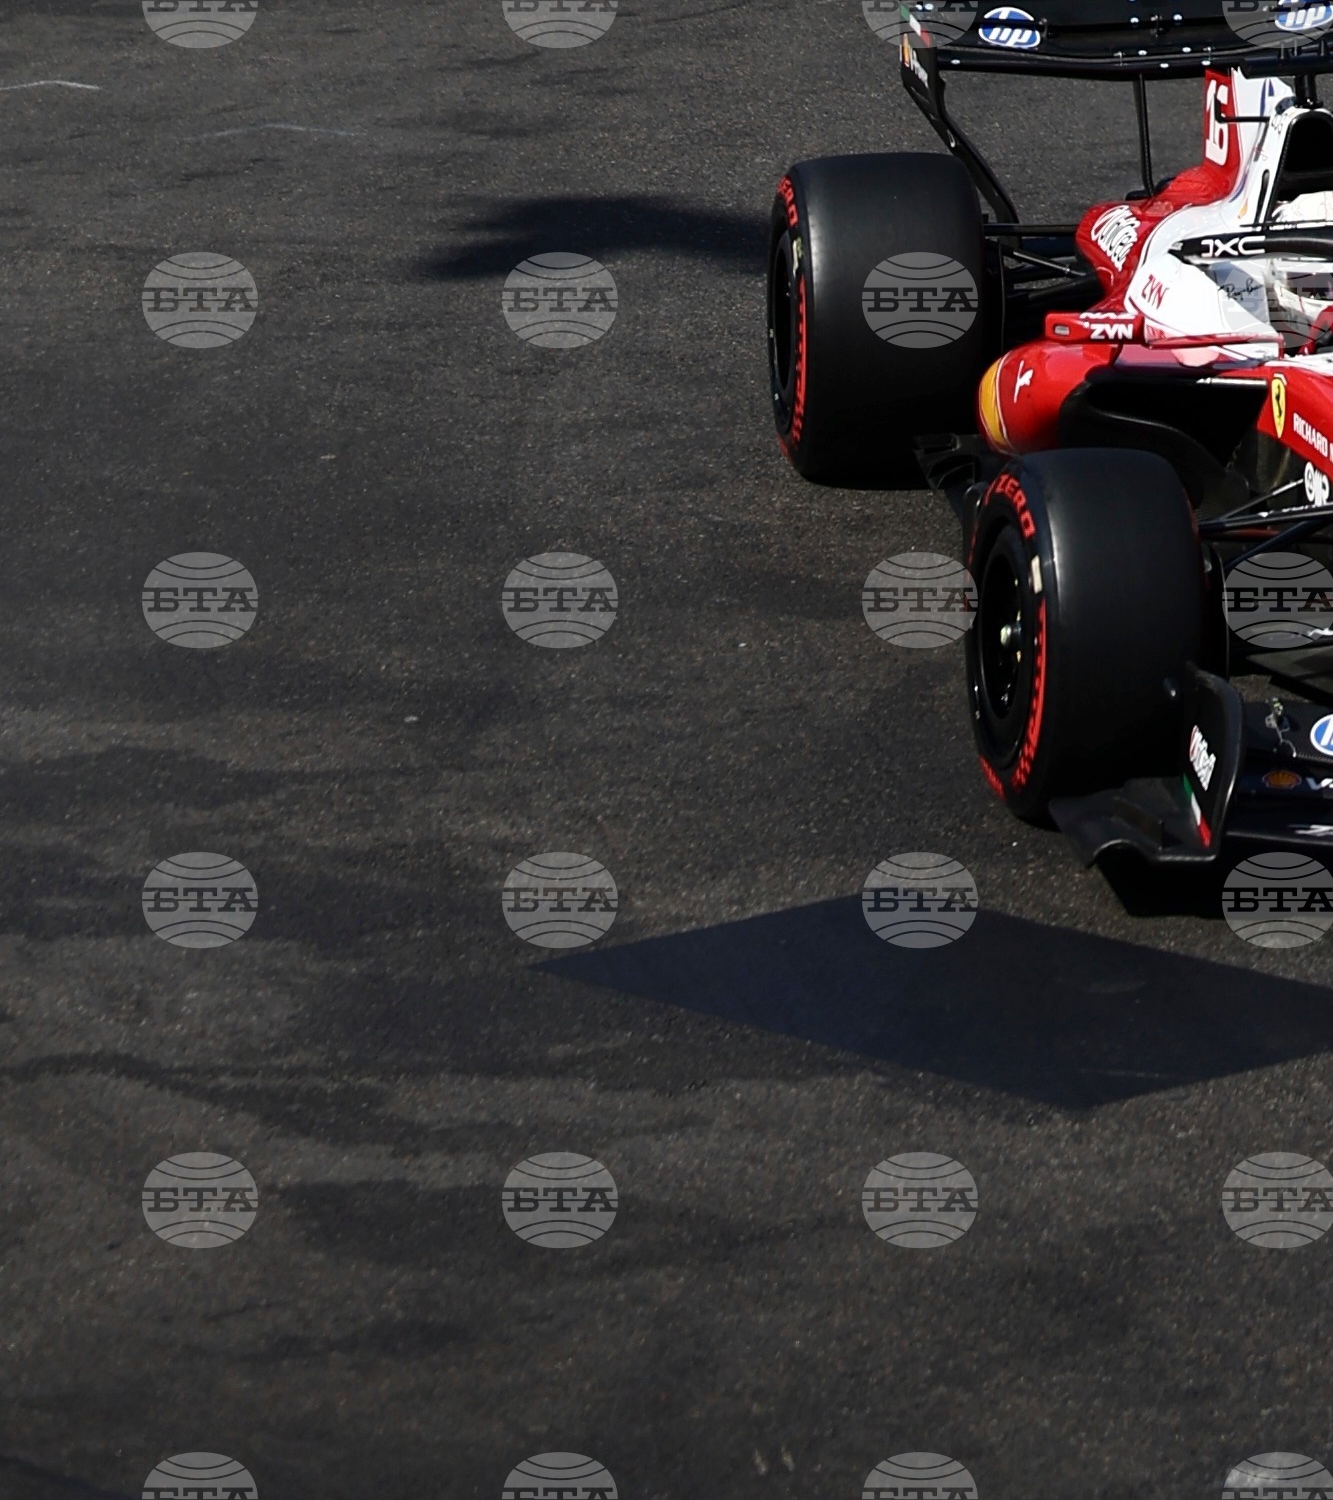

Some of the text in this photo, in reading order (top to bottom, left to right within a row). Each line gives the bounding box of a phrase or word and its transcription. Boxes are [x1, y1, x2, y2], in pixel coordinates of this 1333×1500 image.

[1141, 274, 1169, 310] ZYN
[1090, 323, 1134, 341] ZYN
[1293, 412, 1329, 458] RICHARD
[995, 473, 1037, 540] ZERO
